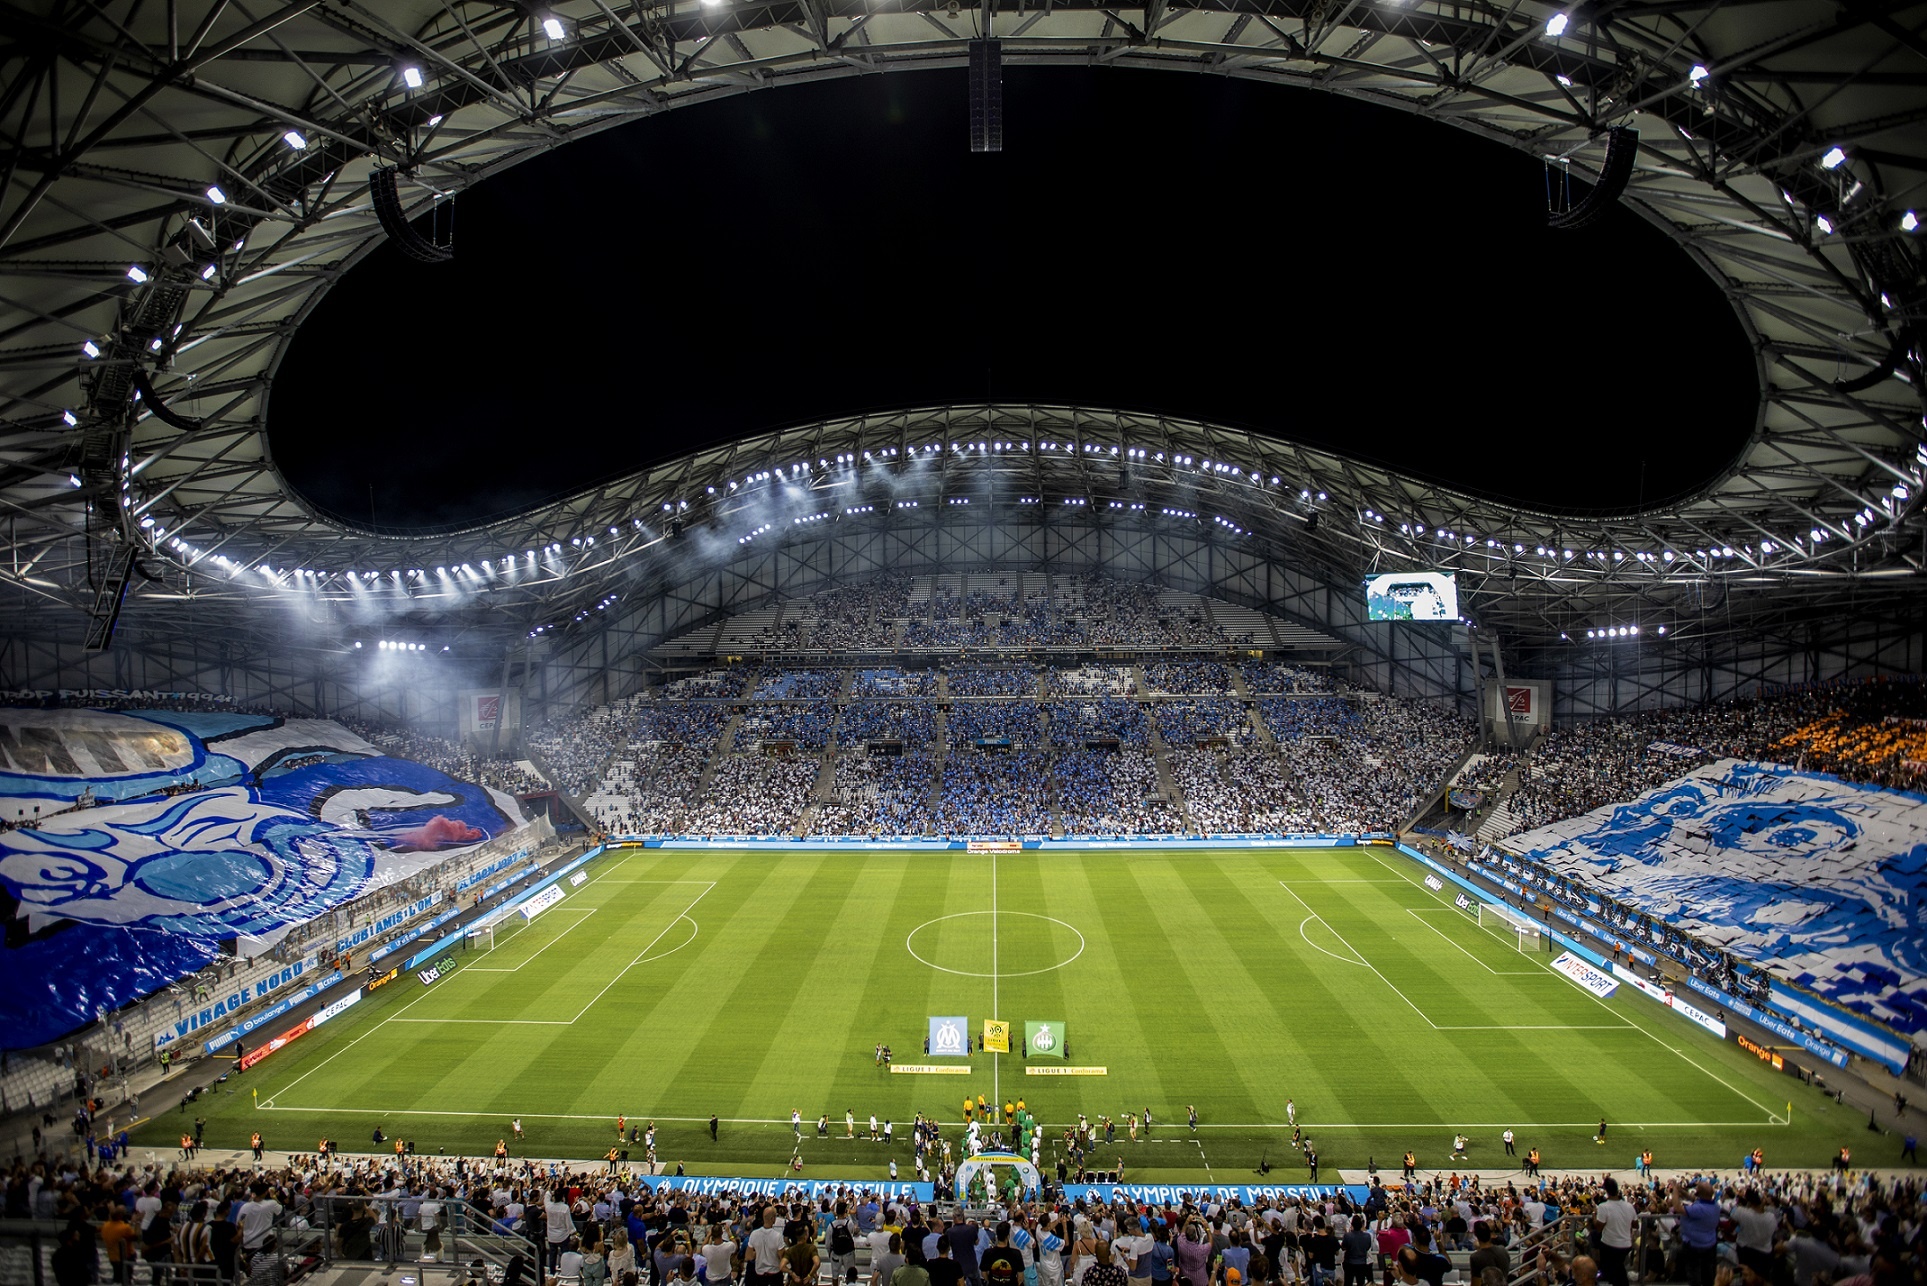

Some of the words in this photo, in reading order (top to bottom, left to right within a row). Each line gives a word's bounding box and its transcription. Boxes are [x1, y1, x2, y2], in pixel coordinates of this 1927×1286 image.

[1456, 893, 1470, 909] Uber
[336, 930, 368, 953] CLUB
[376, 911, 403, 934] AMIS
[1603, 933, 1614, 944] Uber
[323, 973, 340, 986] CEPAC
[418, 967, 440, 985] Uber
[434, 957, 456, 975] Eats
[1563, 959, 1612, 992] INTERSPORT
[369, 974, 390, 991] Orange
[1690, 979, 1704, 991] Uber
[1704, 987, 1720, 999] Eats
[174, 987, 251, 1037] VIRAGE
[256, 961, 303, 996] NORD
[325, 998, 348, 1018] CEPAC
[253, 1003, 286, 1025] boulanger
[1684, 1006, 1709, 1026] CEPAC
[1759, 1015, 1777, 1029] Uber
[1776, 1025, 1795, 1039] Eats
[209, 1032, 233, 1051] PUMA
[1738, 1035, 1772, 1061] Orange
[1805, 1038, 1831, 1057] Orange
